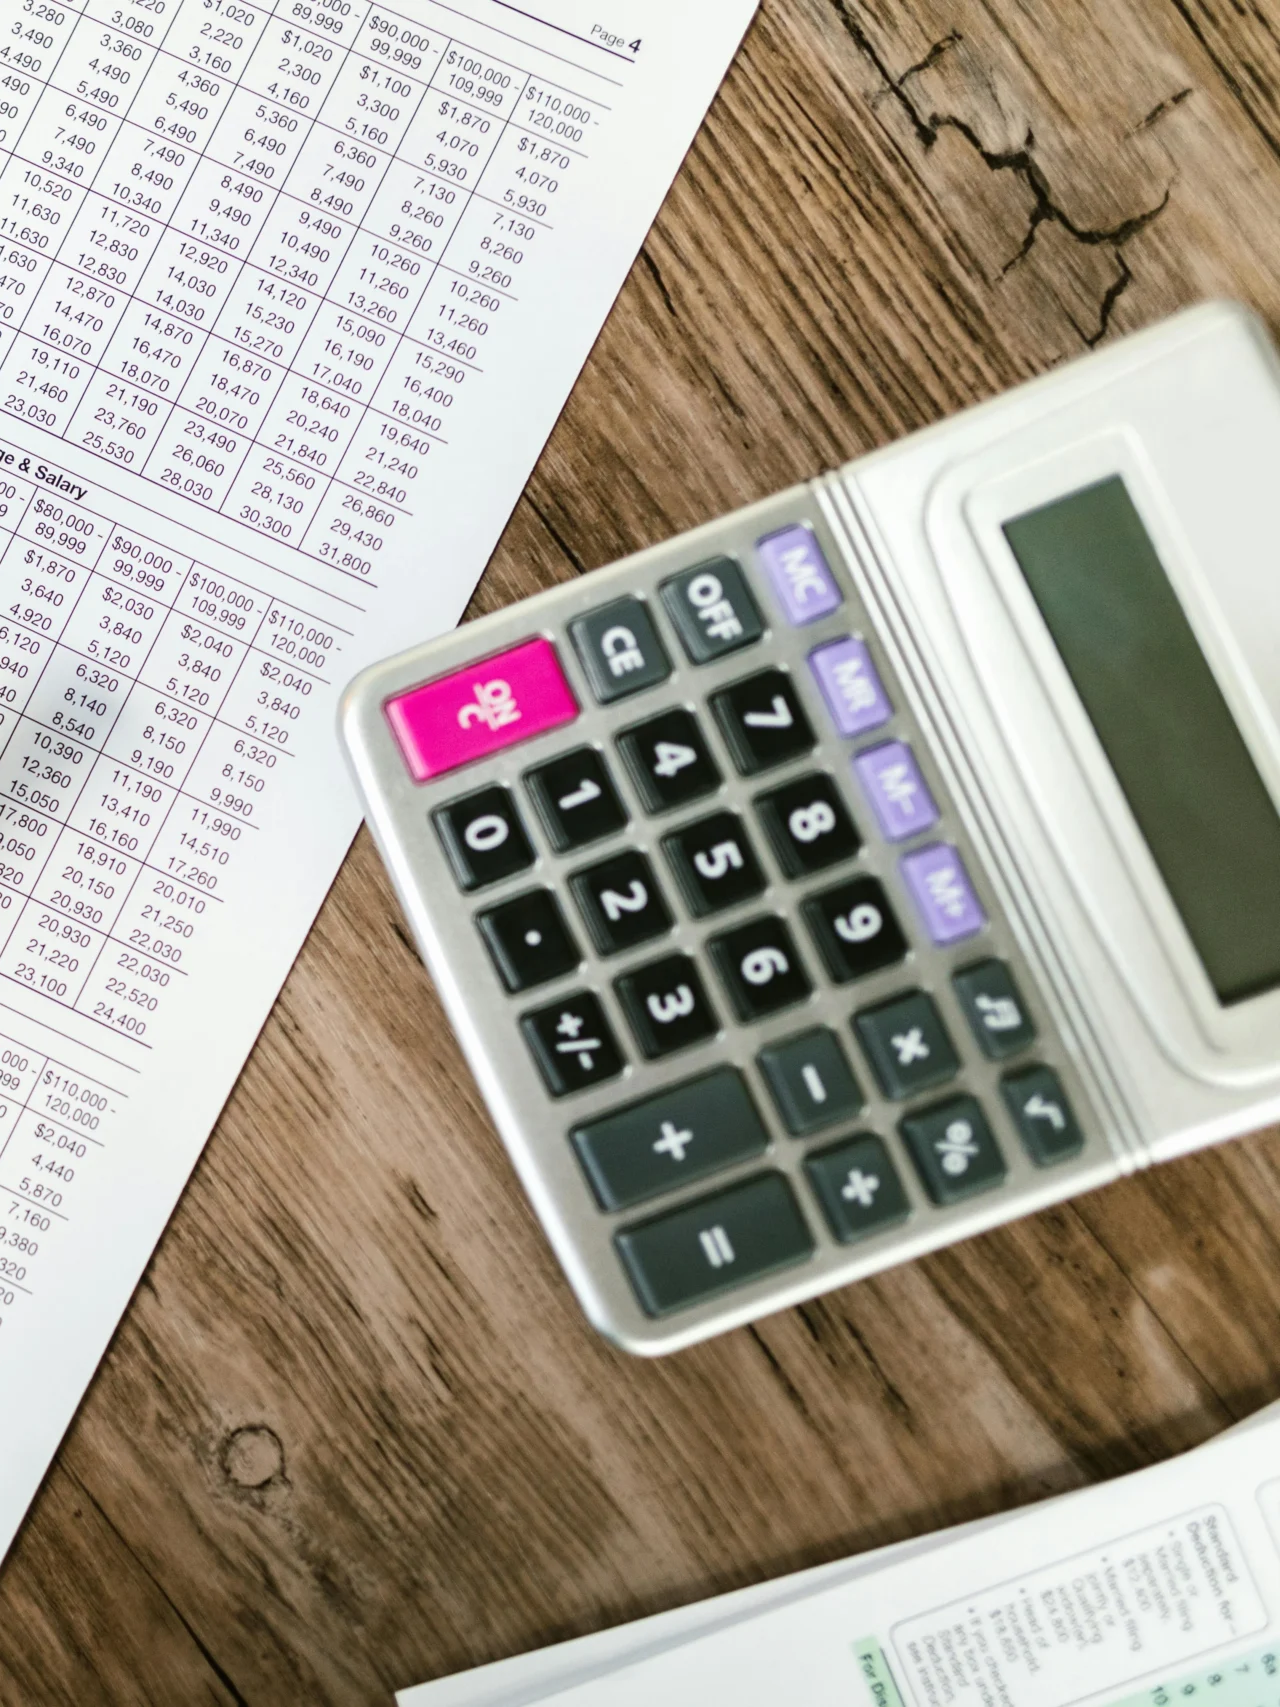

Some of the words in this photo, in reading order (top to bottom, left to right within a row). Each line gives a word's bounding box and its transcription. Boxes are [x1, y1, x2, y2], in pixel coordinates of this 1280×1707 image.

[99, 33, 142, 61] 3,360
[590, 24, 625, 48] Page
[628, 39, 642, 53] 4
[449, 73, 503, 107] 109,999
[255, 104, 298, 132] 5,360
[356, 93, 400, 121] 3,300
[528, 109, 583, 142] 120,000
[517, 137, 570, 169] $1,870
[24, 170, 72, 201] 10,520
[179, 242, 228, 274] 12,920
[415, 351, 465, 384] 15,290
[285, 409, 339, 443] 20,240
[17, 457, 31, 474] &
[34, 464, 88, 501] Salary
[353, 470, 406, 503] 22,840
[341, 494, 395, 527] 26,860
[318, 542, 371, 575] 31,800
[780, 544, 827, 600] MC
[101, 586, 154, 620] $2,030
[192, 595, 246, 630] 109,999
[688, 575, 742, 639] OFF
[602, 627, 644, 675] CE
[832, 657, 877, 713] MR
[458, 707, 484, 730] C
[485, 679, 522, 728] ON
[745, 697, 792, 726] 7
[233, 739, 277, 768] 6,320
[655, 743, 696, 775] 4
[21, 755, 72, 789] 12,360
[560, 780, 600, 809] 1
[466, 816, 508, 850] 0
[790, 802, 834, 841] 8
[695, 842, 742, 877] 5
[152, 880, 206, 914] 20,010
[601, 881, 647, 919] 2
[835, 905, 881, 941] 9
[742, 948, 787, 983] 6
[93, 1001, 146, 1035] 24,400
[648, 986, 693, 1021] 3
[859, 1653, 877, 1678] For
[1206, 1673, 1223, 1686] 8
[1234, 1662, 1251, 1673] 7
[1261, 1653, 1276, 1675] 6a
[1150, 1685, 1170, 1706] 10
[1180, 1683, 1196, 1696] 9
